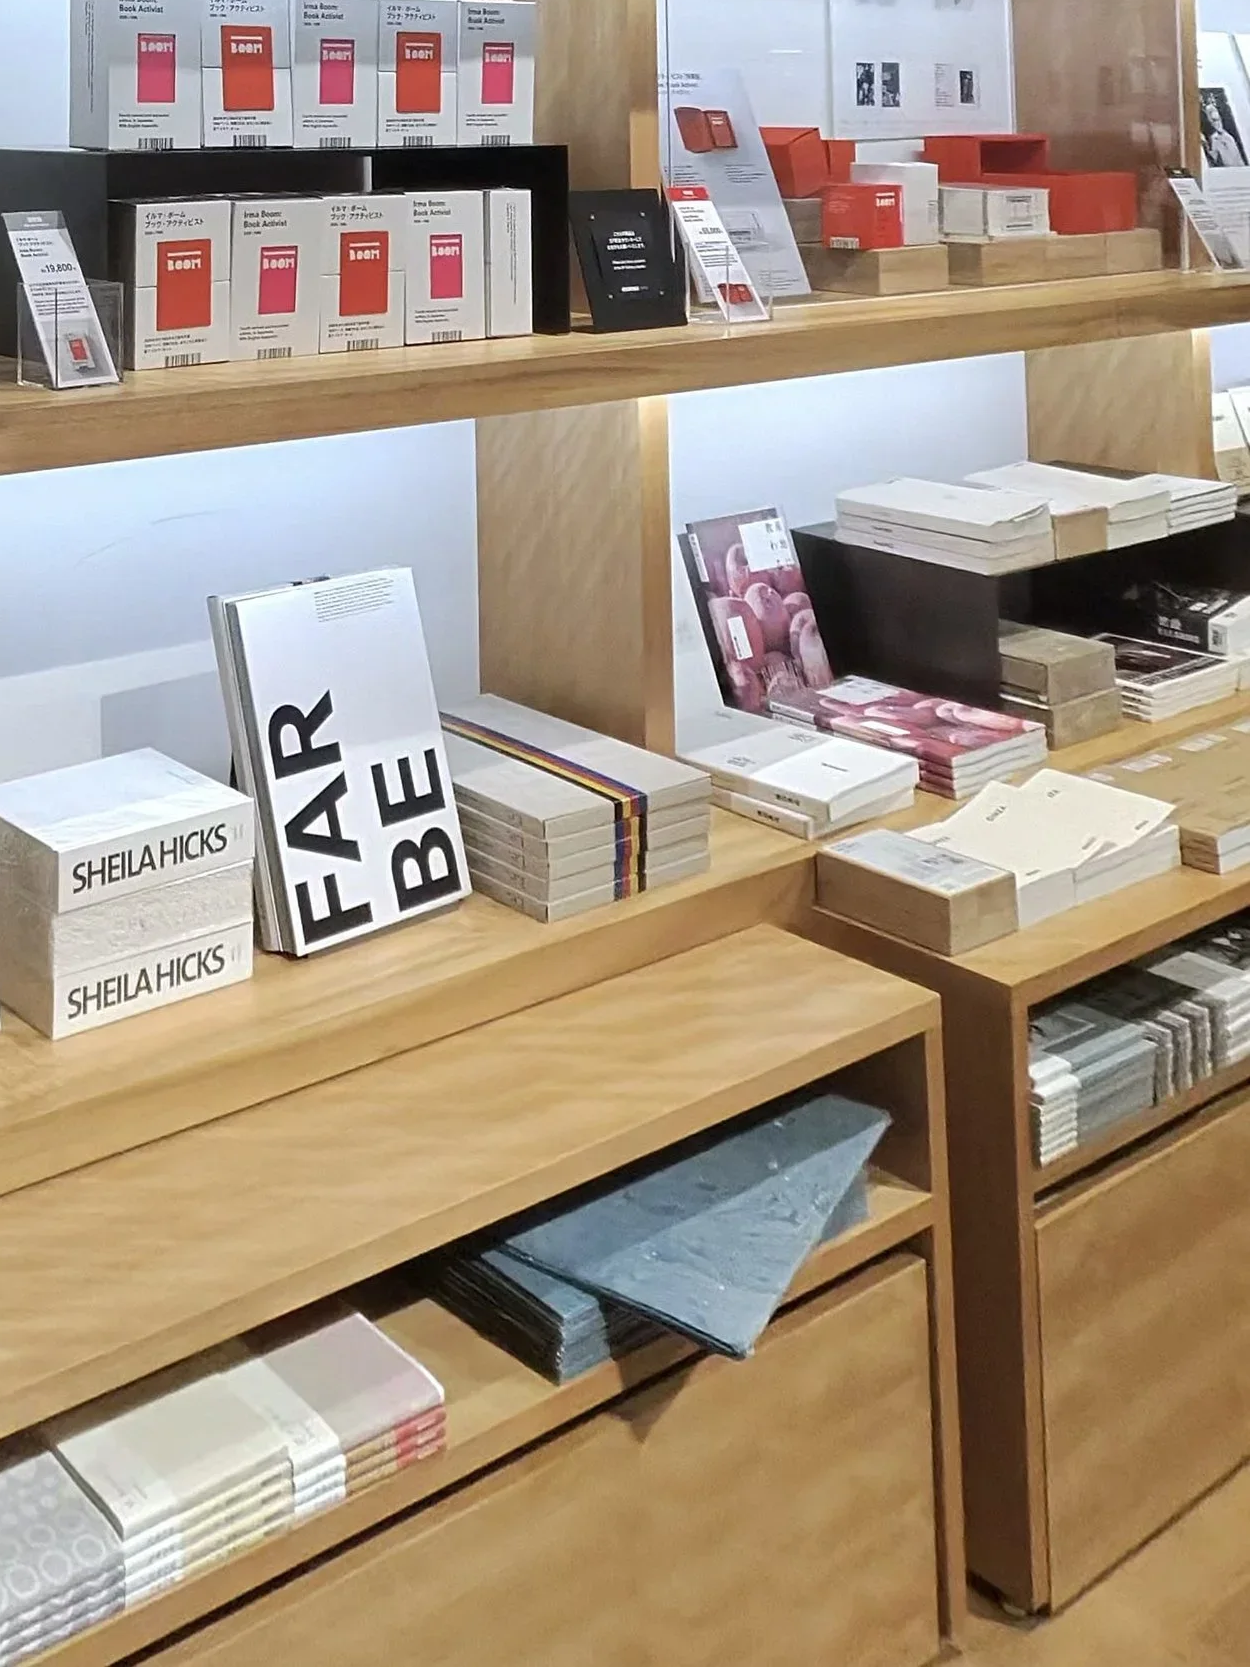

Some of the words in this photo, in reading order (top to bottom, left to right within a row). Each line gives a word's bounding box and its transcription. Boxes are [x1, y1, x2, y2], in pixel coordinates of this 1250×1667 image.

[119, 3, 137, 12] Book
[140, 40, 174, 53] BOOM
[230, 42, 263, 54] BOOM
[167, 258, 202, 272] BOOM
[263, 257, 295, 271] BOOM
[267, 688, 374, 946] FAR
[370, 747, 463, 914] BE
[72, 843, 157, 895] SHEILA
[159, 822, 228, 869] HICKS
[66, 966, 154, 1021] SHEILA
[156, 943, 226, 993] HICKS
